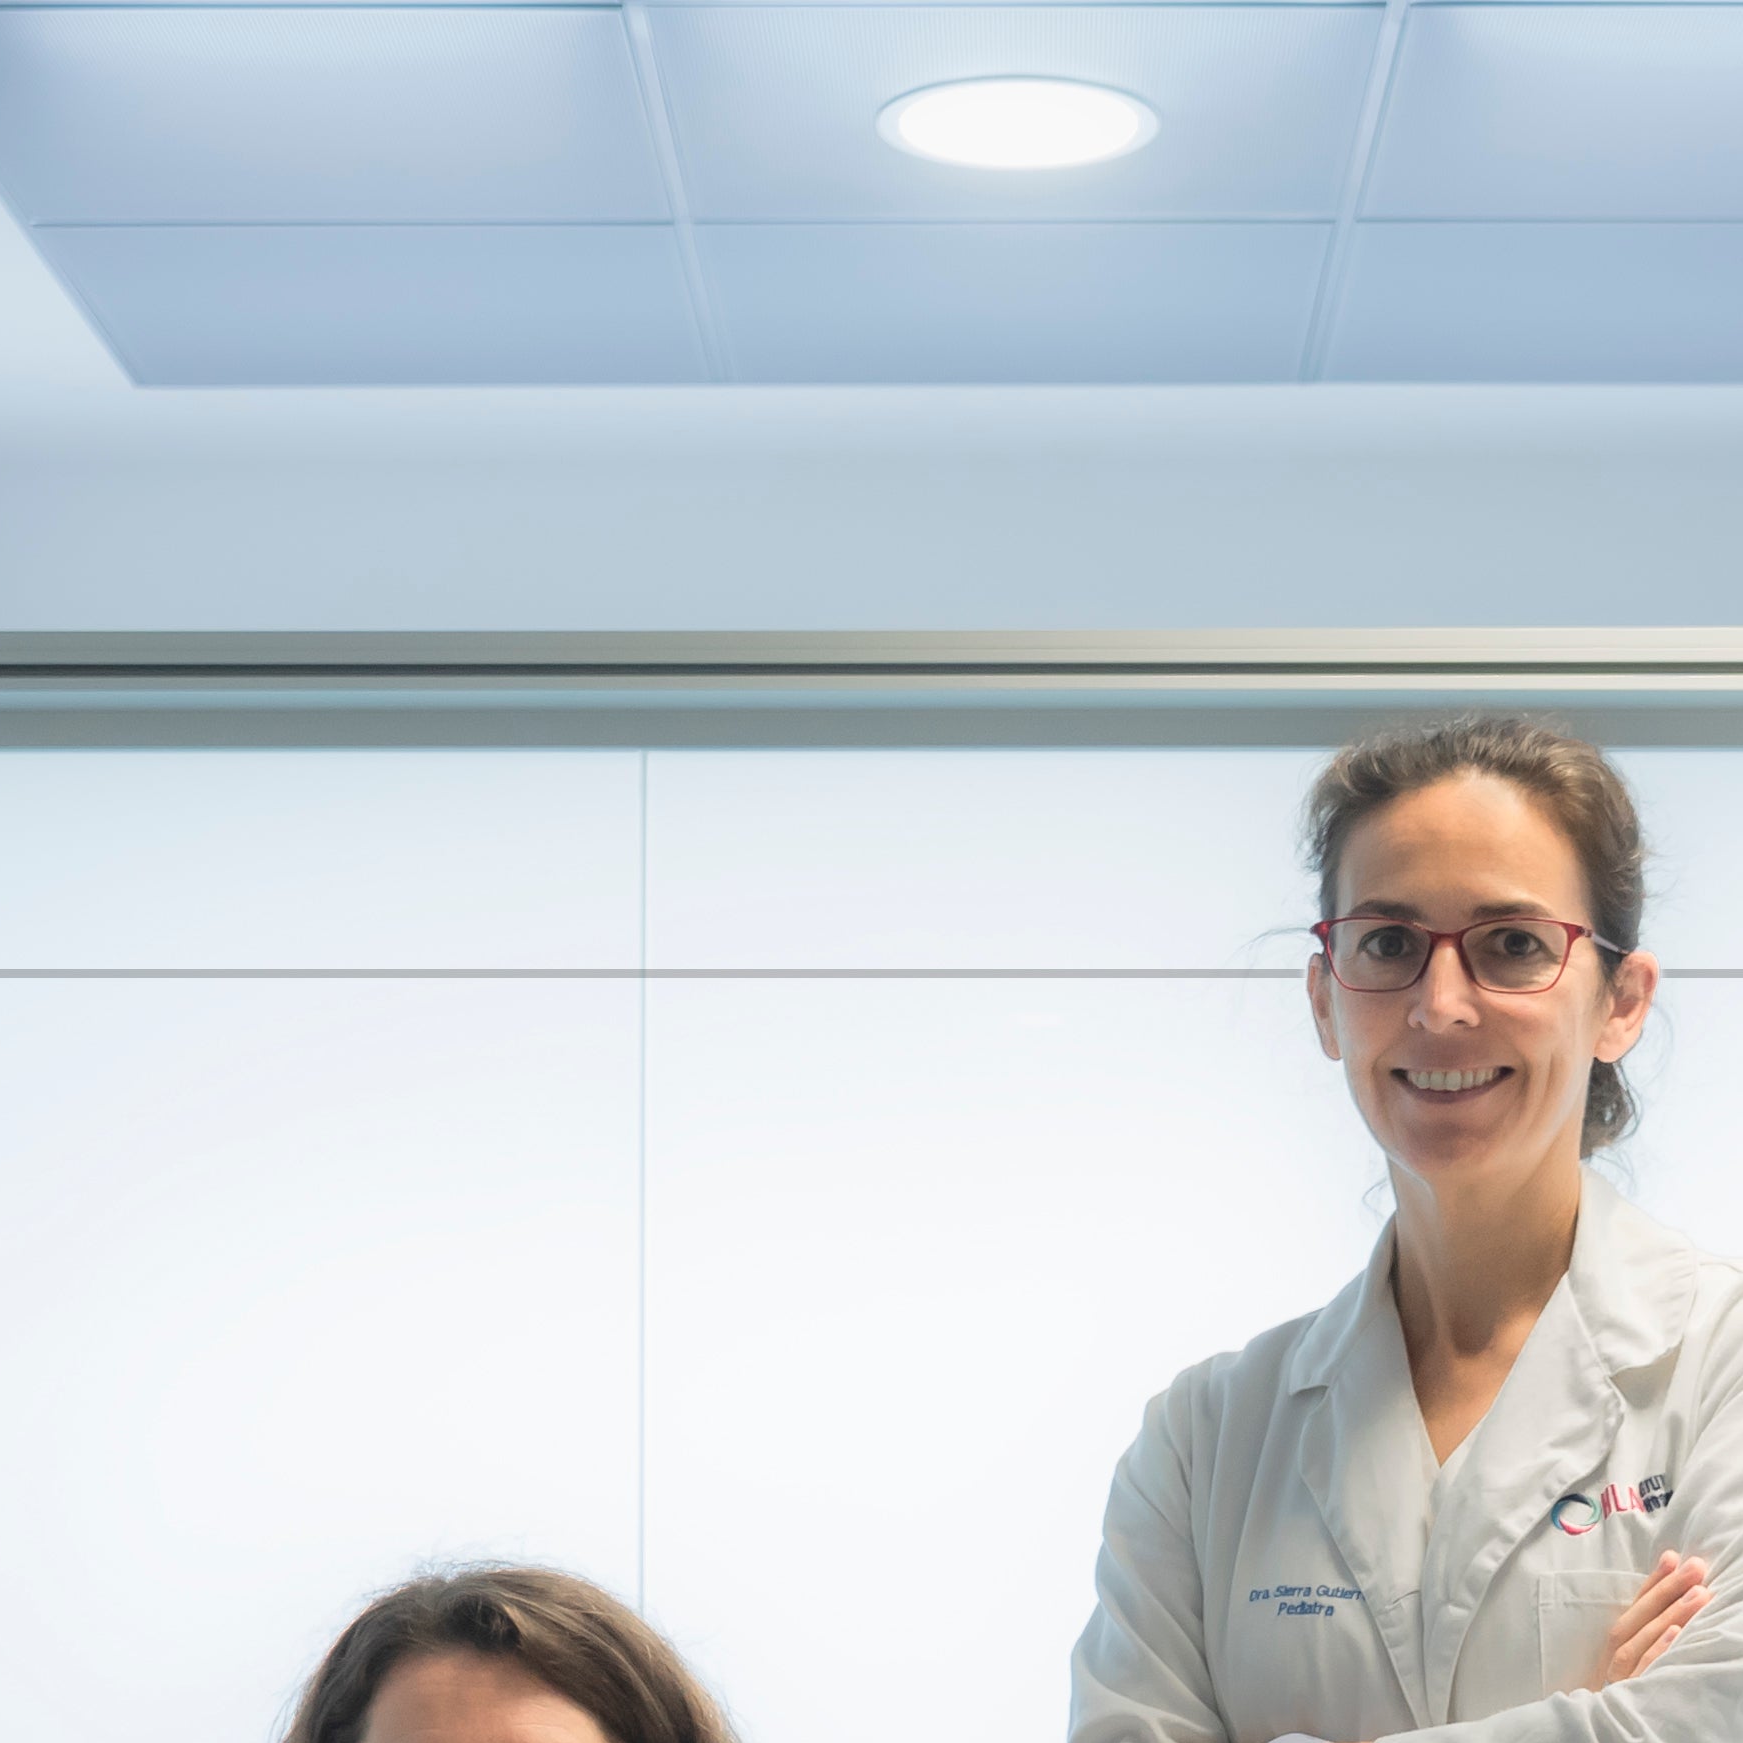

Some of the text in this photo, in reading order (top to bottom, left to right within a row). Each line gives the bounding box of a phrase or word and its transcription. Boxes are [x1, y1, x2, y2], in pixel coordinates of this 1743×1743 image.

[1600, 1483, 1646, 1520] HLA
[1249, 1588, 1270, 1602] Dra
[1277, 1601, 1334, 1616] Pediatra
